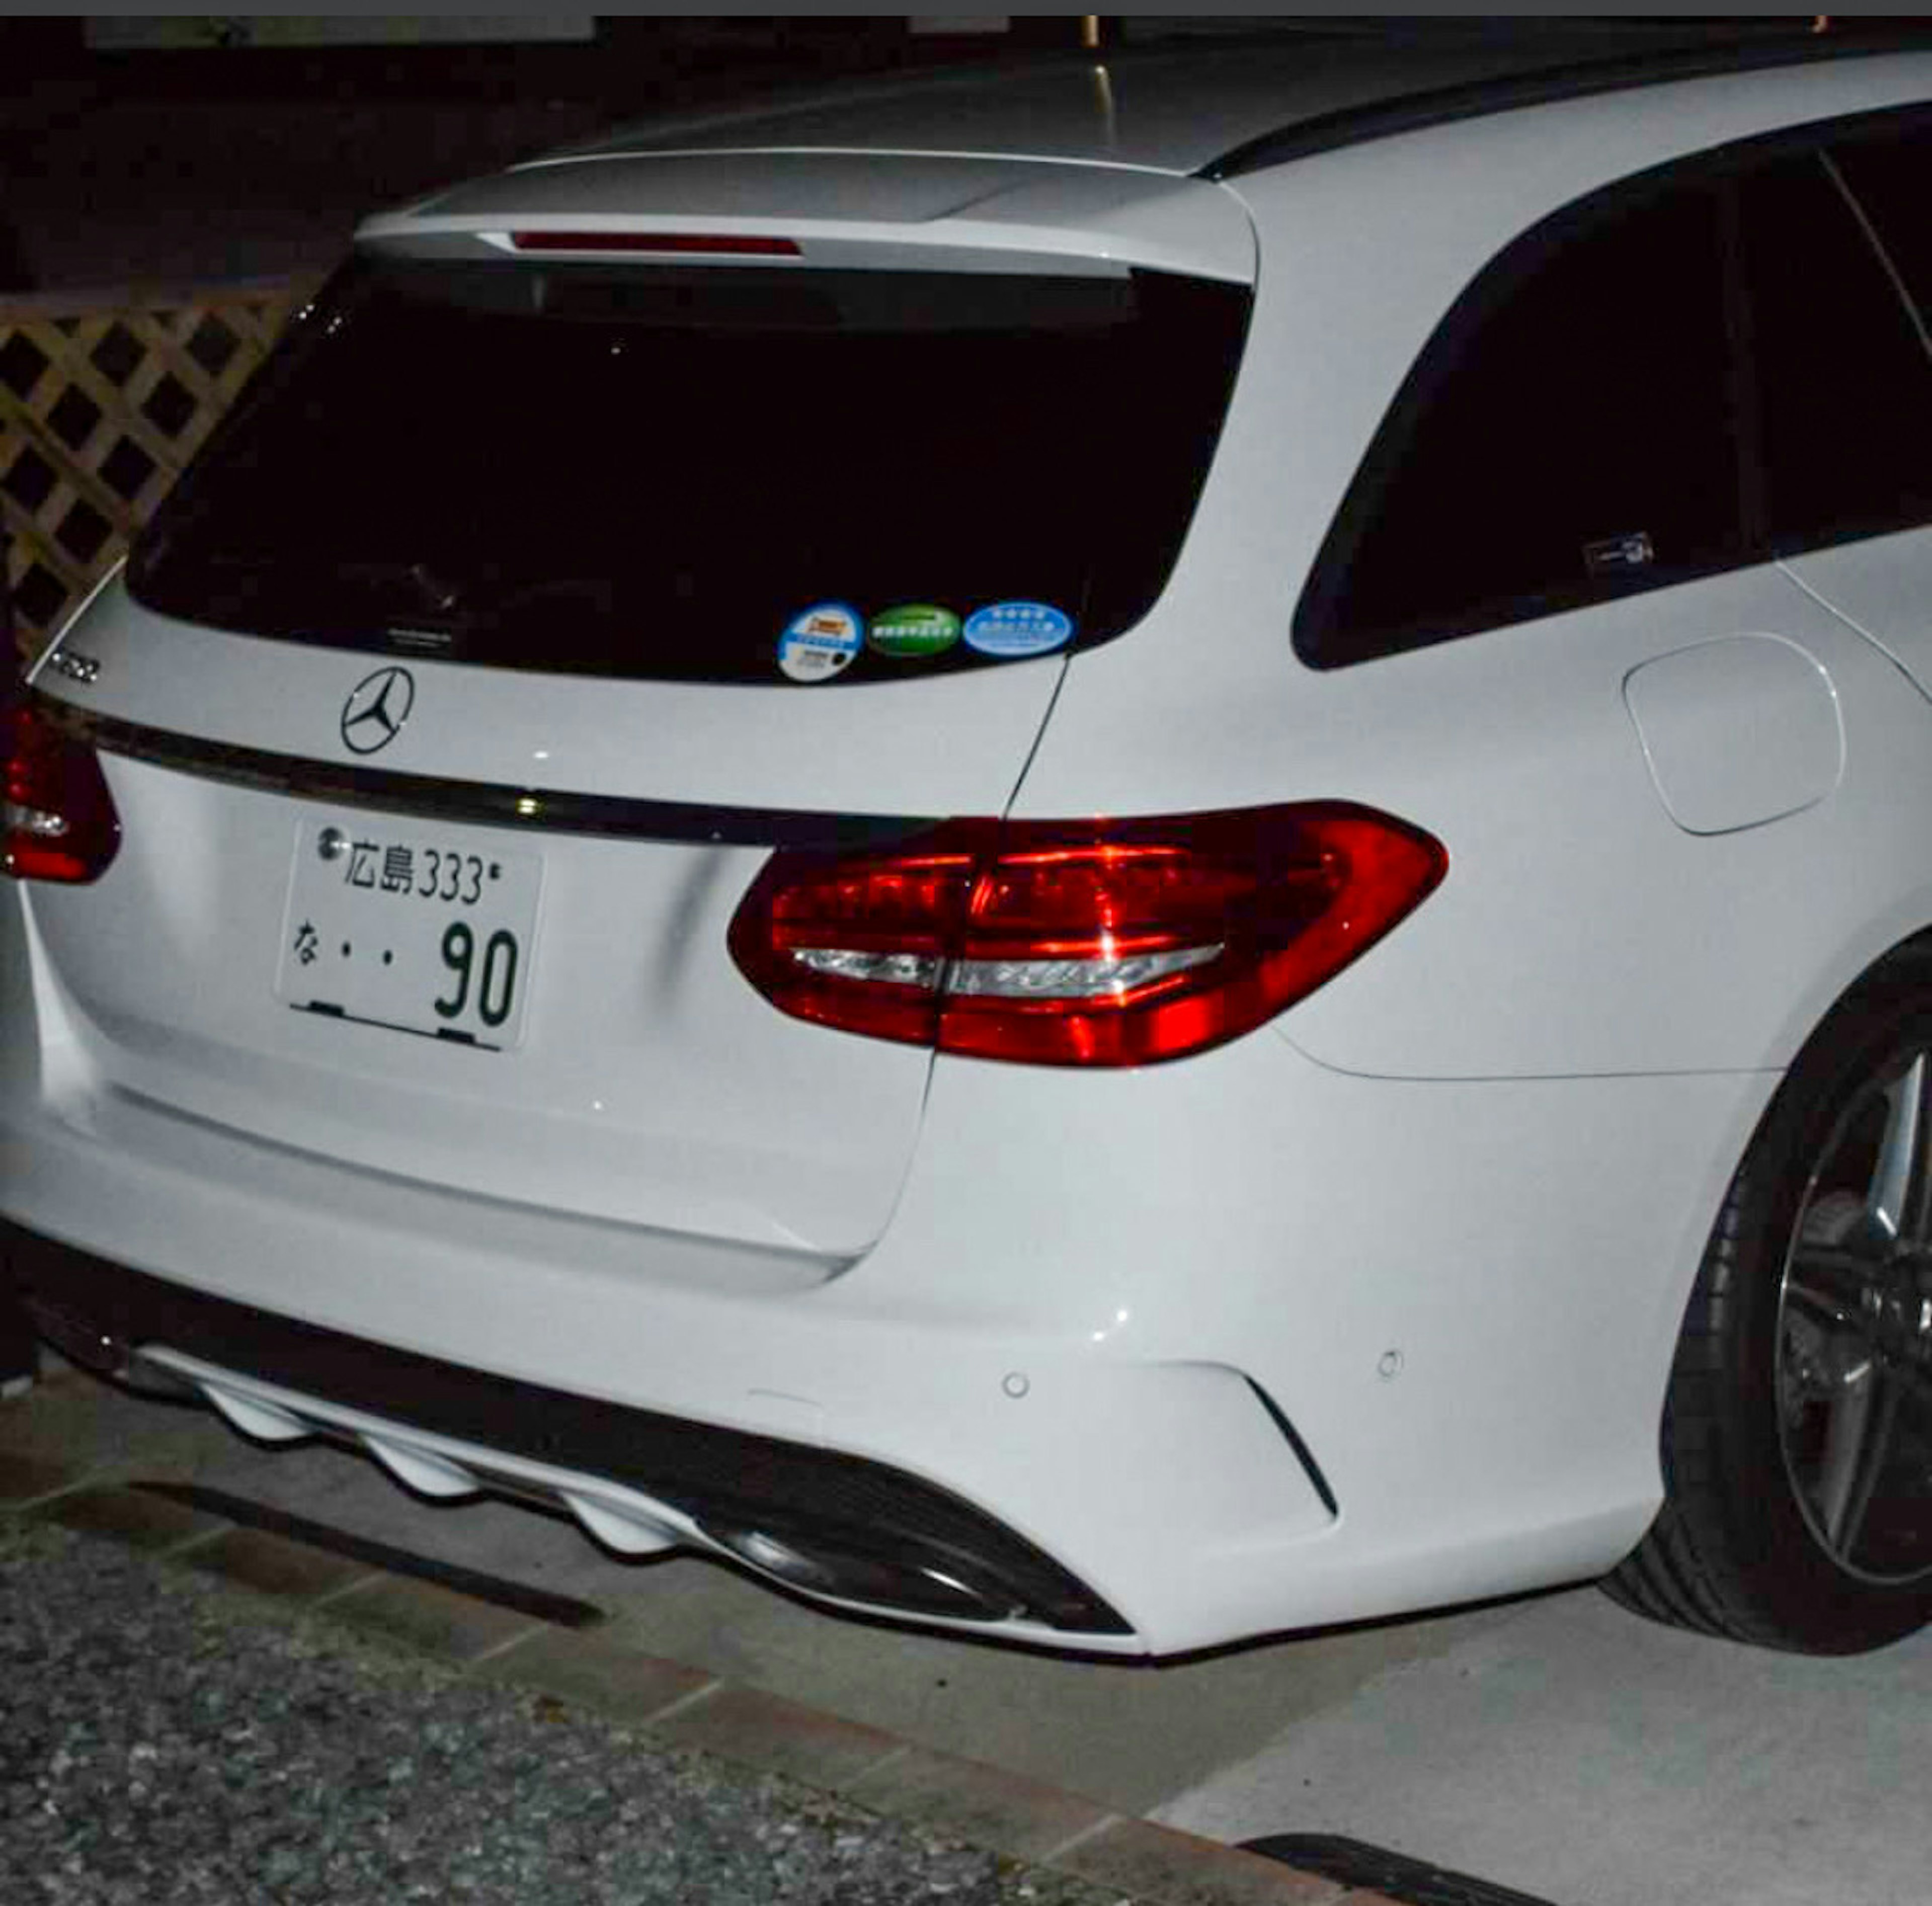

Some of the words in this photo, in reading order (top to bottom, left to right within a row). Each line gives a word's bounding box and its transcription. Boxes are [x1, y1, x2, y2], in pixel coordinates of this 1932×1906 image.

[345, 839, 413, 894] 広島
[419, 849, 483, 905] 333
[294, 920, 319, 965] な
[434, 921, 518, 1026] 90
